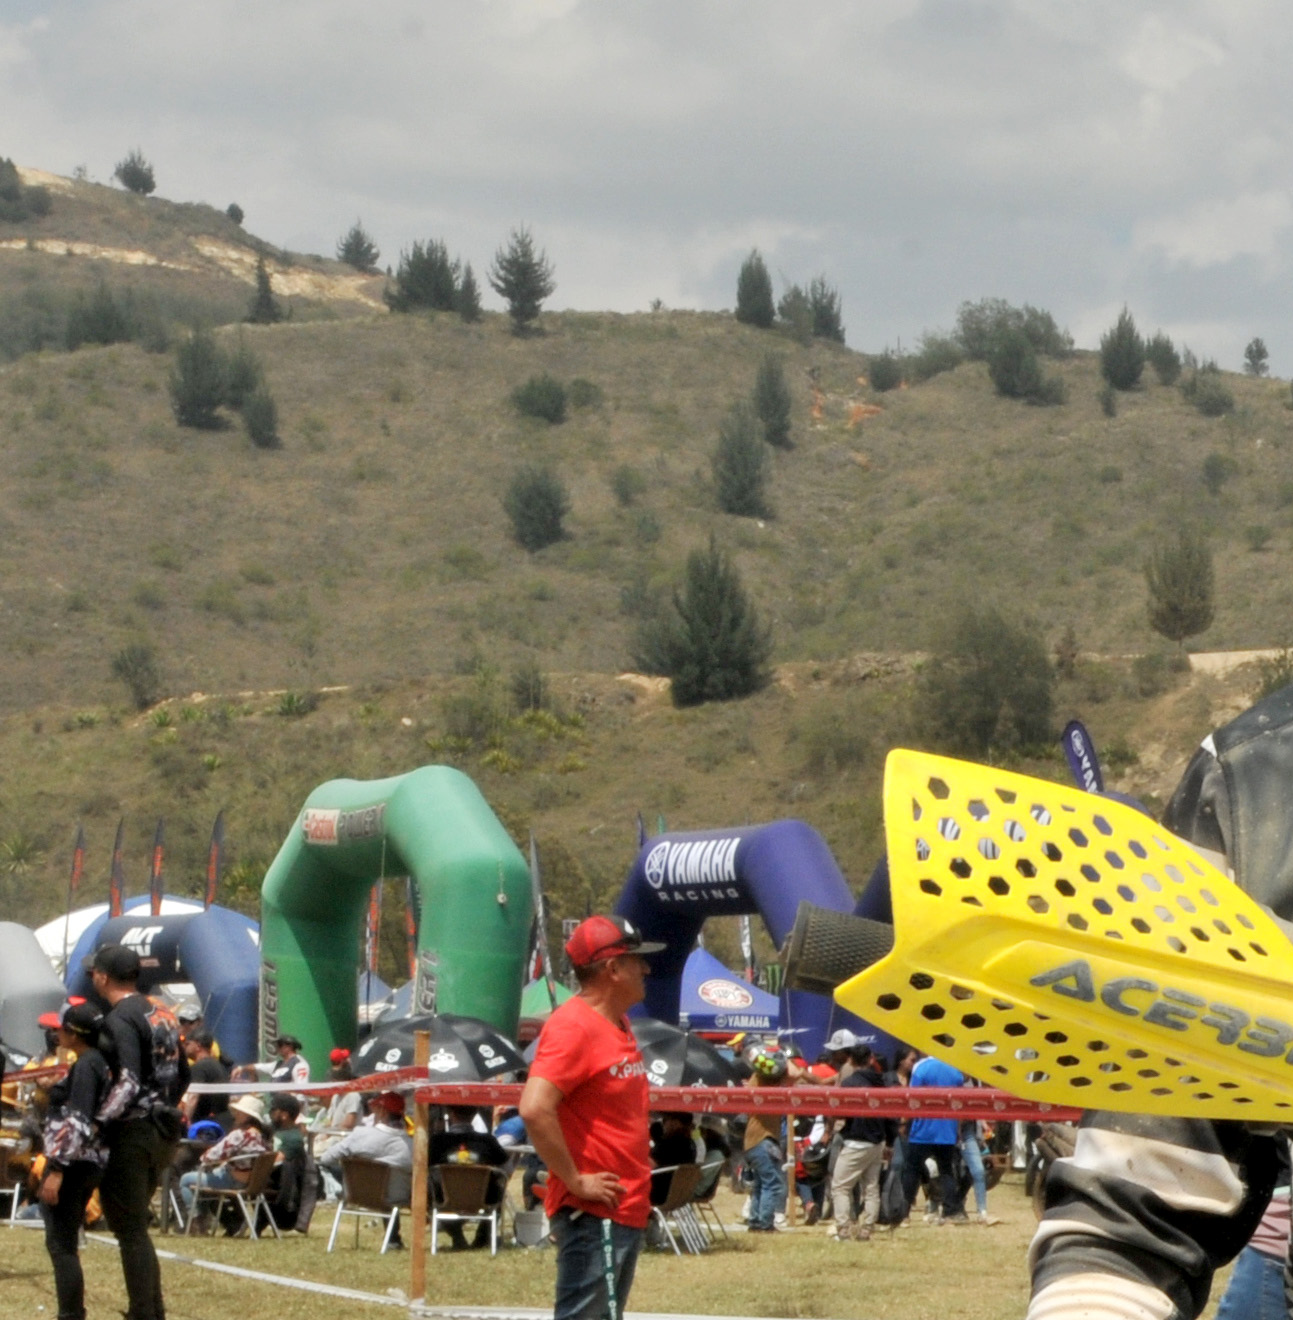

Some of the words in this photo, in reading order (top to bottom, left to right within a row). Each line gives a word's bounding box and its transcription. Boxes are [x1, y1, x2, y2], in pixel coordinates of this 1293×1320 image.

[667, 836, 741, 886] YAMAHA
[657, 887, 740, 902] RACING
[727, 1015, 771, 1028] YAMAHA
